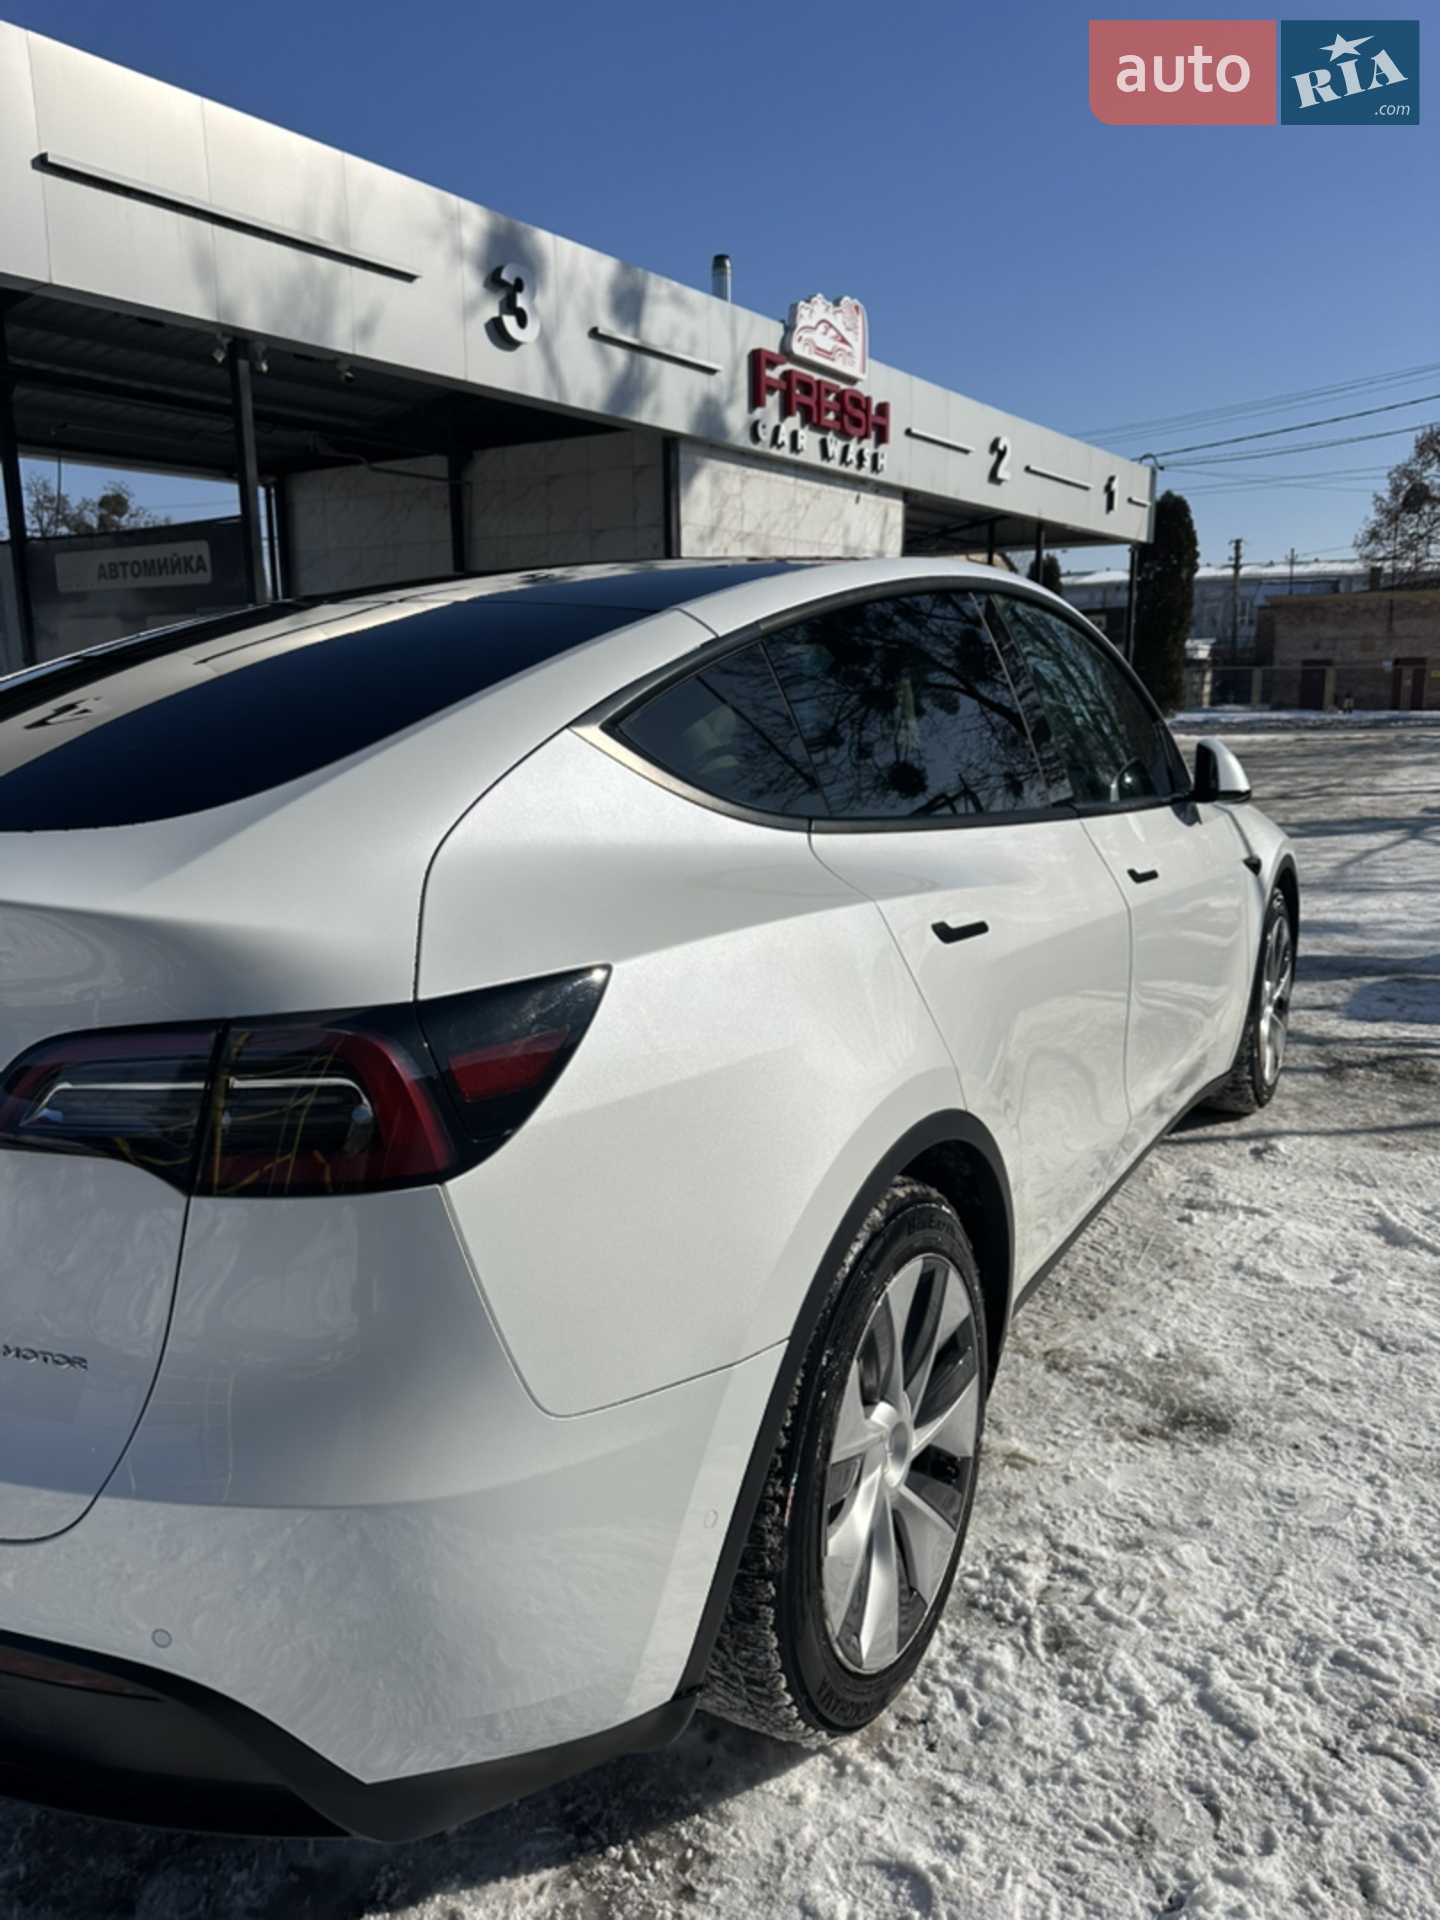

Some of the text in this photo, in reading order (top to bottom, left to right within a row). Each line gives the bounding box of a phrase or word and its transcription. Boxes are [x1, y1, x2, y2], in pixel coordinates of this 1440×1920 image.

[488, 262, 541, 347] 3
[748, 348, 890, 446] FRESH
[750, 416, 888, 476] CAR WASH
[988, 436, 1011, 486] 2
[1104, 475, 1119, 514] 1
[97, 553, 208, 581] АВТОМИЙКА
[3, 1343, 89, 1371] MOTOR
